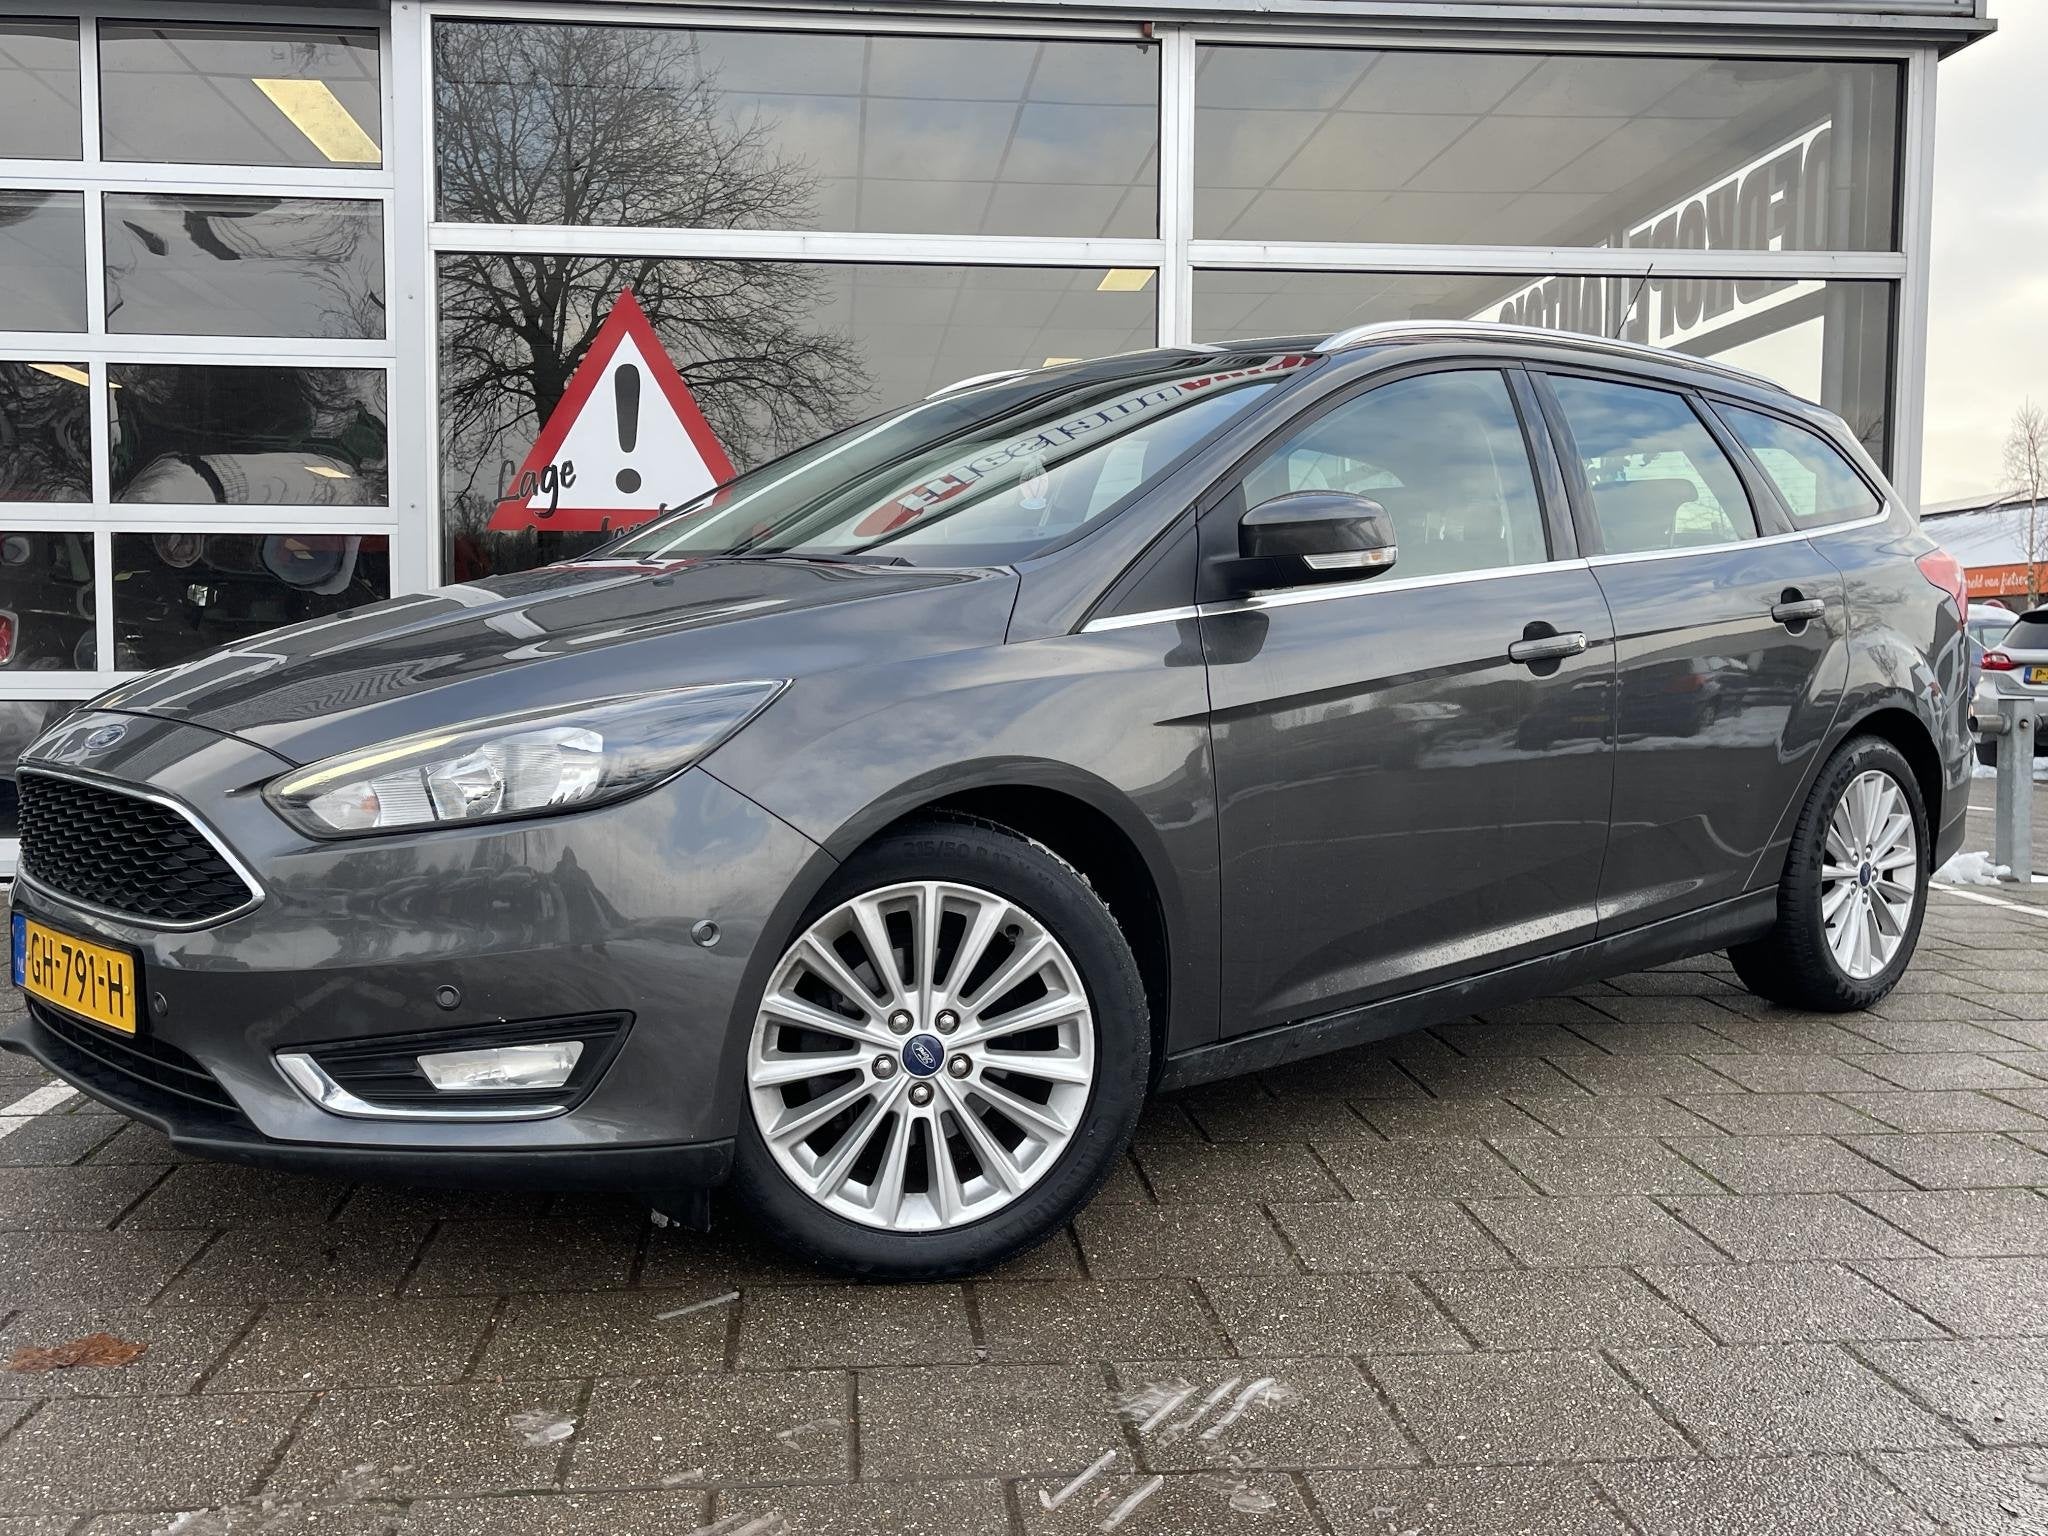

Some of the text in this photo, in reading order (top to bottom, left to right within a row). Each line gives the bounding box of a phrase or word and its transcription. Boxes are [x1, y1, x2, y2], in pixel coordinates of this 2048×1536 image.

[493, 459, 577, 518] Lage
[32, 932, 124, 1018] GH-791-H
[916, 1046, 933, 1065] Ford
